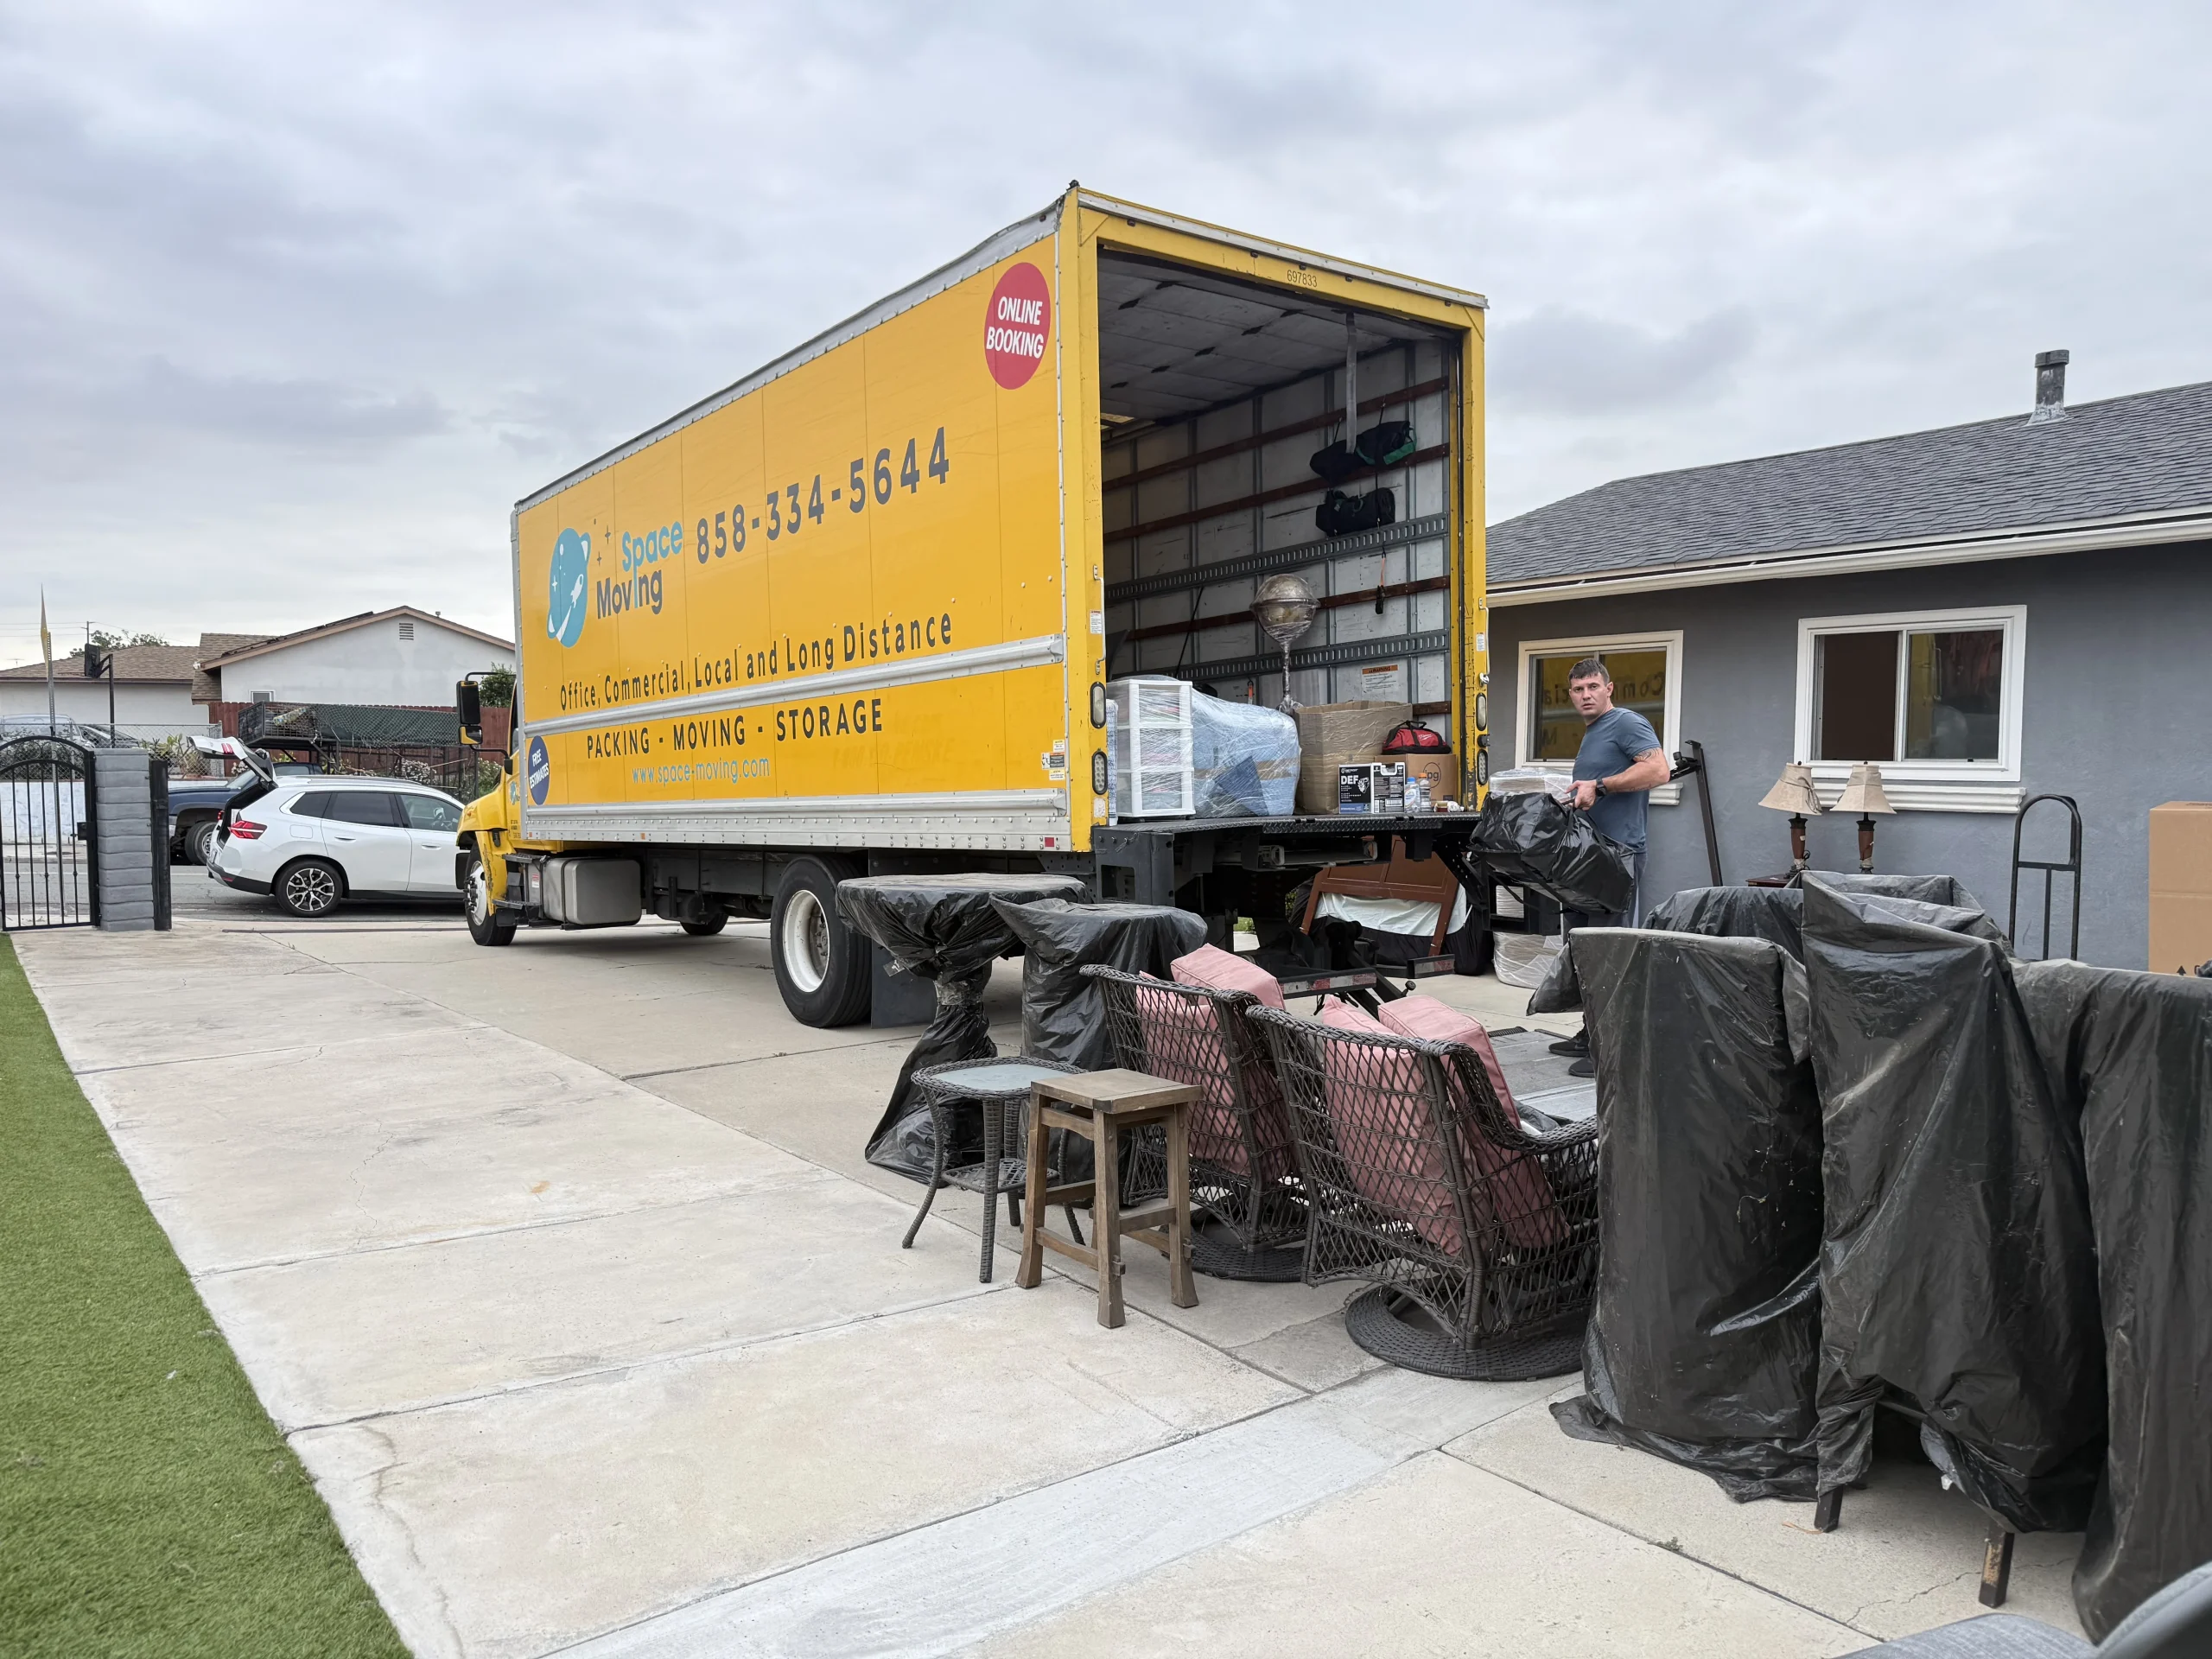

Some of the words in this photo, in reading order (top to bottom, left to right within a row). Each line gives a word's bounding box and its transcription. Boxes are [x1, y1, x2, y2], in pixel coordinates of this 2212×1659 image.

[1287, 269, 1318, 288] 697833
[997, 296, 1043, 326] ONLINE
[986, 326, 1045, 359] BOOKING
[696, 426, 950, 564] 858-334-5644
[622, 521, 683, 608] Space
[596, 569, 663, 620] Moving
[560, 680, 601, 711] Office,
[604, 660, 691, 703] Commercial,
[694, 648, 739, 689] Local
[747, 640, 778, 679] and
[785, 638, 835, 671] Long
[842, 613, 951, 663] Distance
[588, 727, 650, 759] PACKING
[673, 715, 746, 751] MOVING
[776, 698, 882, 742] STORAGE
[531, 748, 543, 767] FREE
[632, 757, 771, 788] www.space-moving.com
[529, 762, 550, 789] ESTIMATES
[1340, 774, 1359, 785] DEF
